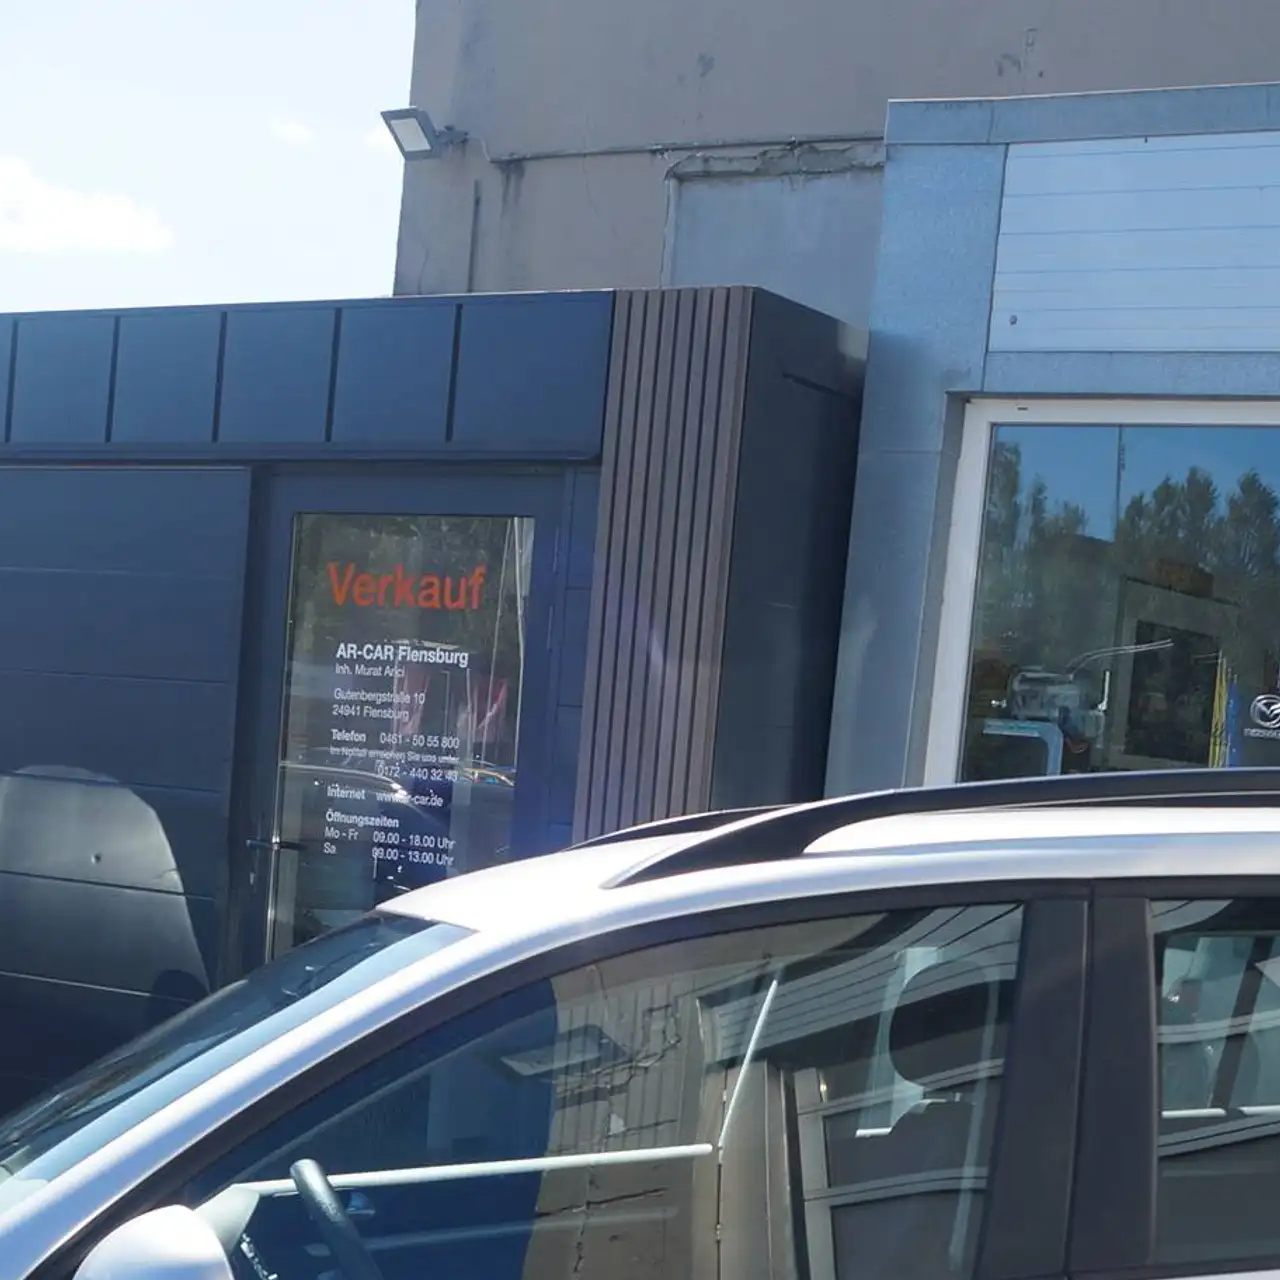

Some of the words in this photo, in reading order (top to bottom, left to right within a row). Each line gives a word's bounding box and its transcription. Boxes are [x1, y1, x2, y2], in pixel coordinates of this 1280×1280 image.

[326, 562, 487, 610] Verkauf
[336, 643, 394, 661] AR-CAR
[398, 646, 469, 667] Flensburg
[335, 663, 352, 675] Inh.
[355, 664, 382, 676] Murat
[414, 692, 426, 704] 10
[332, 704, 360, 716] 24941
[363, 706, 409, 722] Flensburg
[330, 729, 366, 742] Telefon
[412, 735, 424, 746] 50
[426, 736, 439, 748] 55
[327, 785, 365, 799] Internet
[326, 809, 399, 828] Öffnungszeiten
[324, 827, 340, 839] Mo
[348, 829, 359, 840] Fr
[324, 842, 336, 854] Sa
[437, 837, 456, 849] Uhr
[435, 853, 455, 865] Uhr
